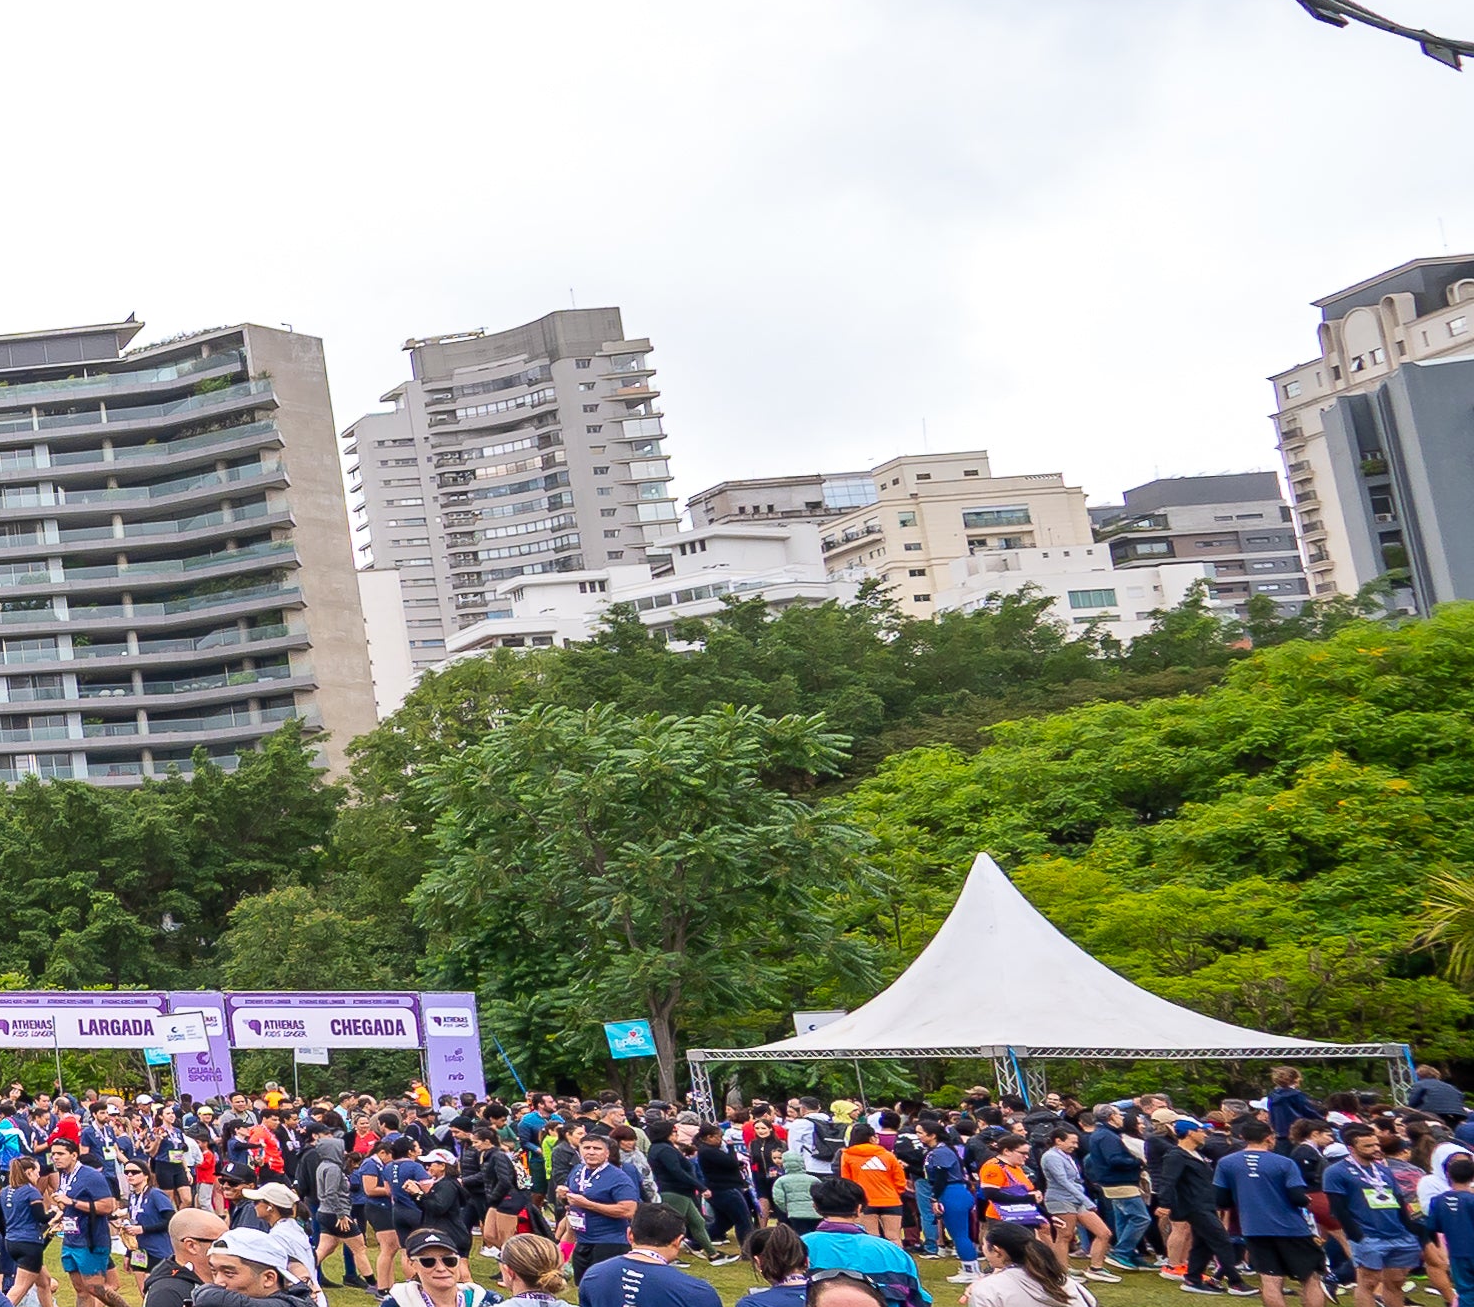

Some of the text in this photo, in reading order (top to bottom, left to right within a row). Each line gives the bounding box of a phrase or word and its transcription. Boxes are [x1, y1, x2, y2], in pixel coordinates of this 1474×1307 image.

[11, 1019, 53, 1030] ATHENAS
[78, 1018, 155, 1036] LARGADA
[264, 1019, 305, 1031] ATHENAS
[330, 1018, 407, 1037] CHEGADA
